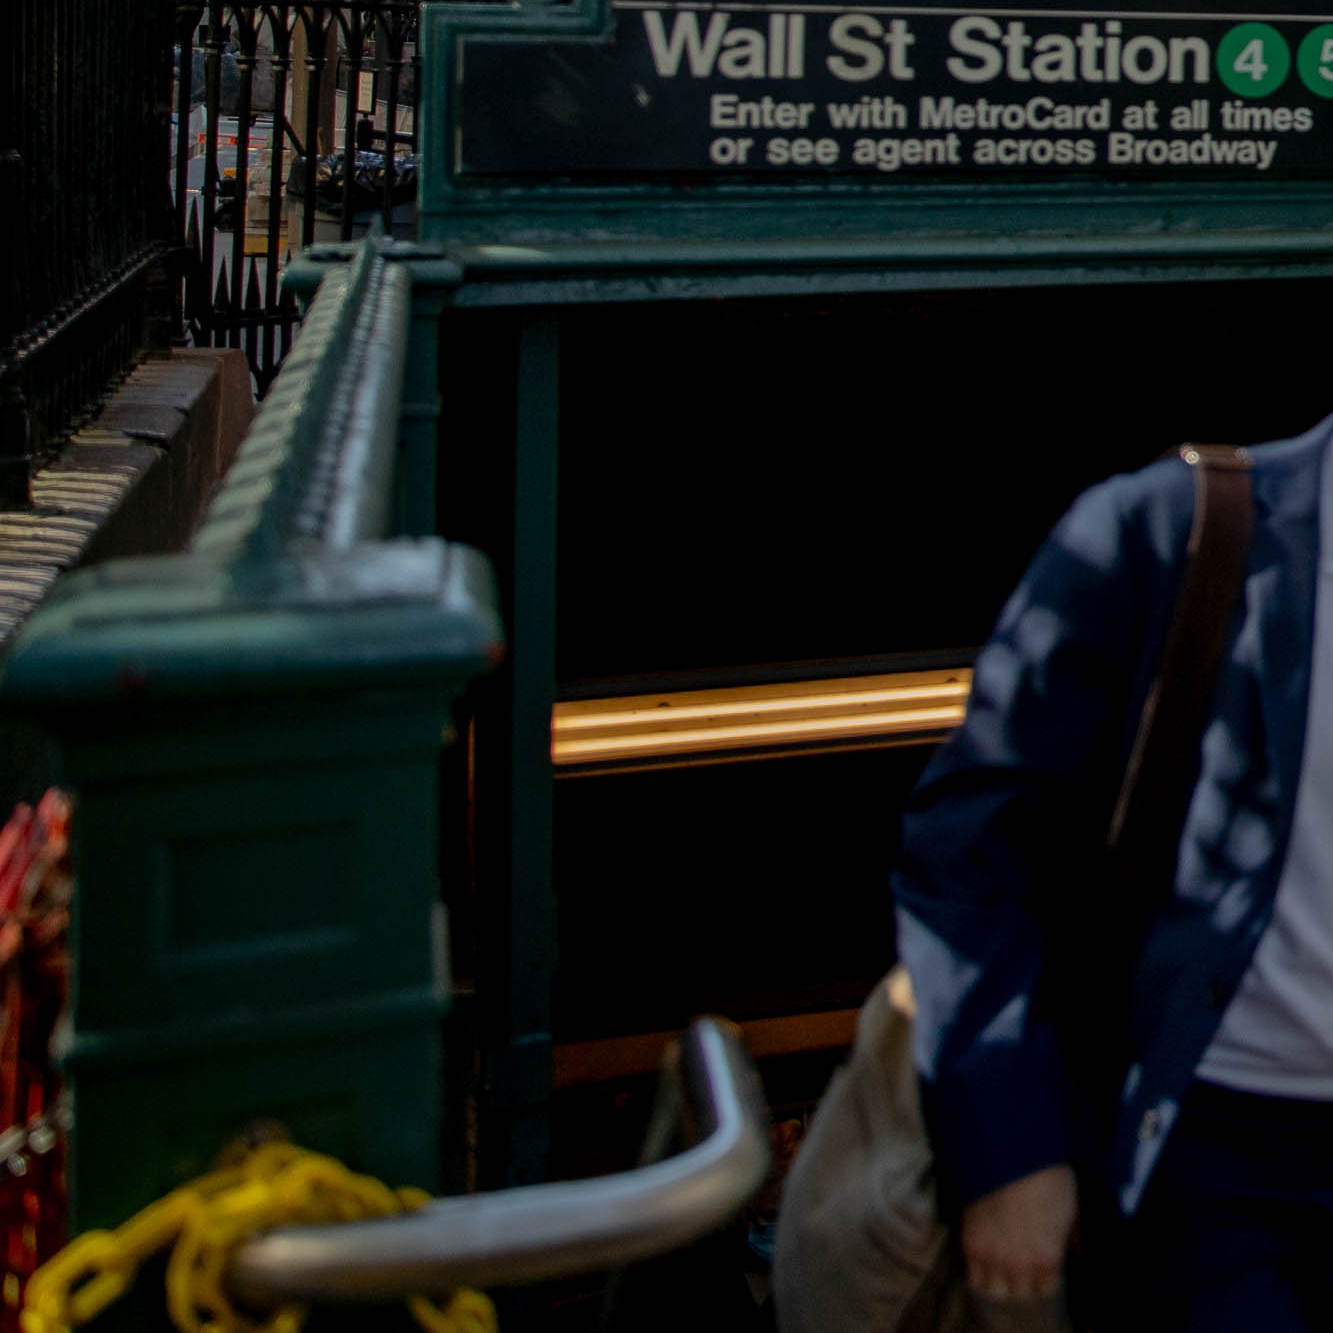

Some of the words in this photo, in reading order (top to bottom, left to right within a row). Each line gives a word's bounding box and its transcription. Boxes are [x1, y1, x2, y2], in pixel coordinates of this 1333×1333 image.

[643, 10, 806, 80] Wall
[826, 13, 915, 83] St
[946, 15, 1210, 84] Station
[710, 93, 814, 130] Enter
[827, 95, 908, 130] with
[919, 96, 1111, 132] MetroCard
[1122, 100, 1159, 132] at
[1170, 99, 1209, 132] all
[1220, 100, 1314, 133] times
[709, 136, 753, 166] or
[766, 136, 841, 166] see
[852, 132, 961, 173] agent
[972, 137, 1097, 167] across
[1107, 132, 1278, 171] Broadway
